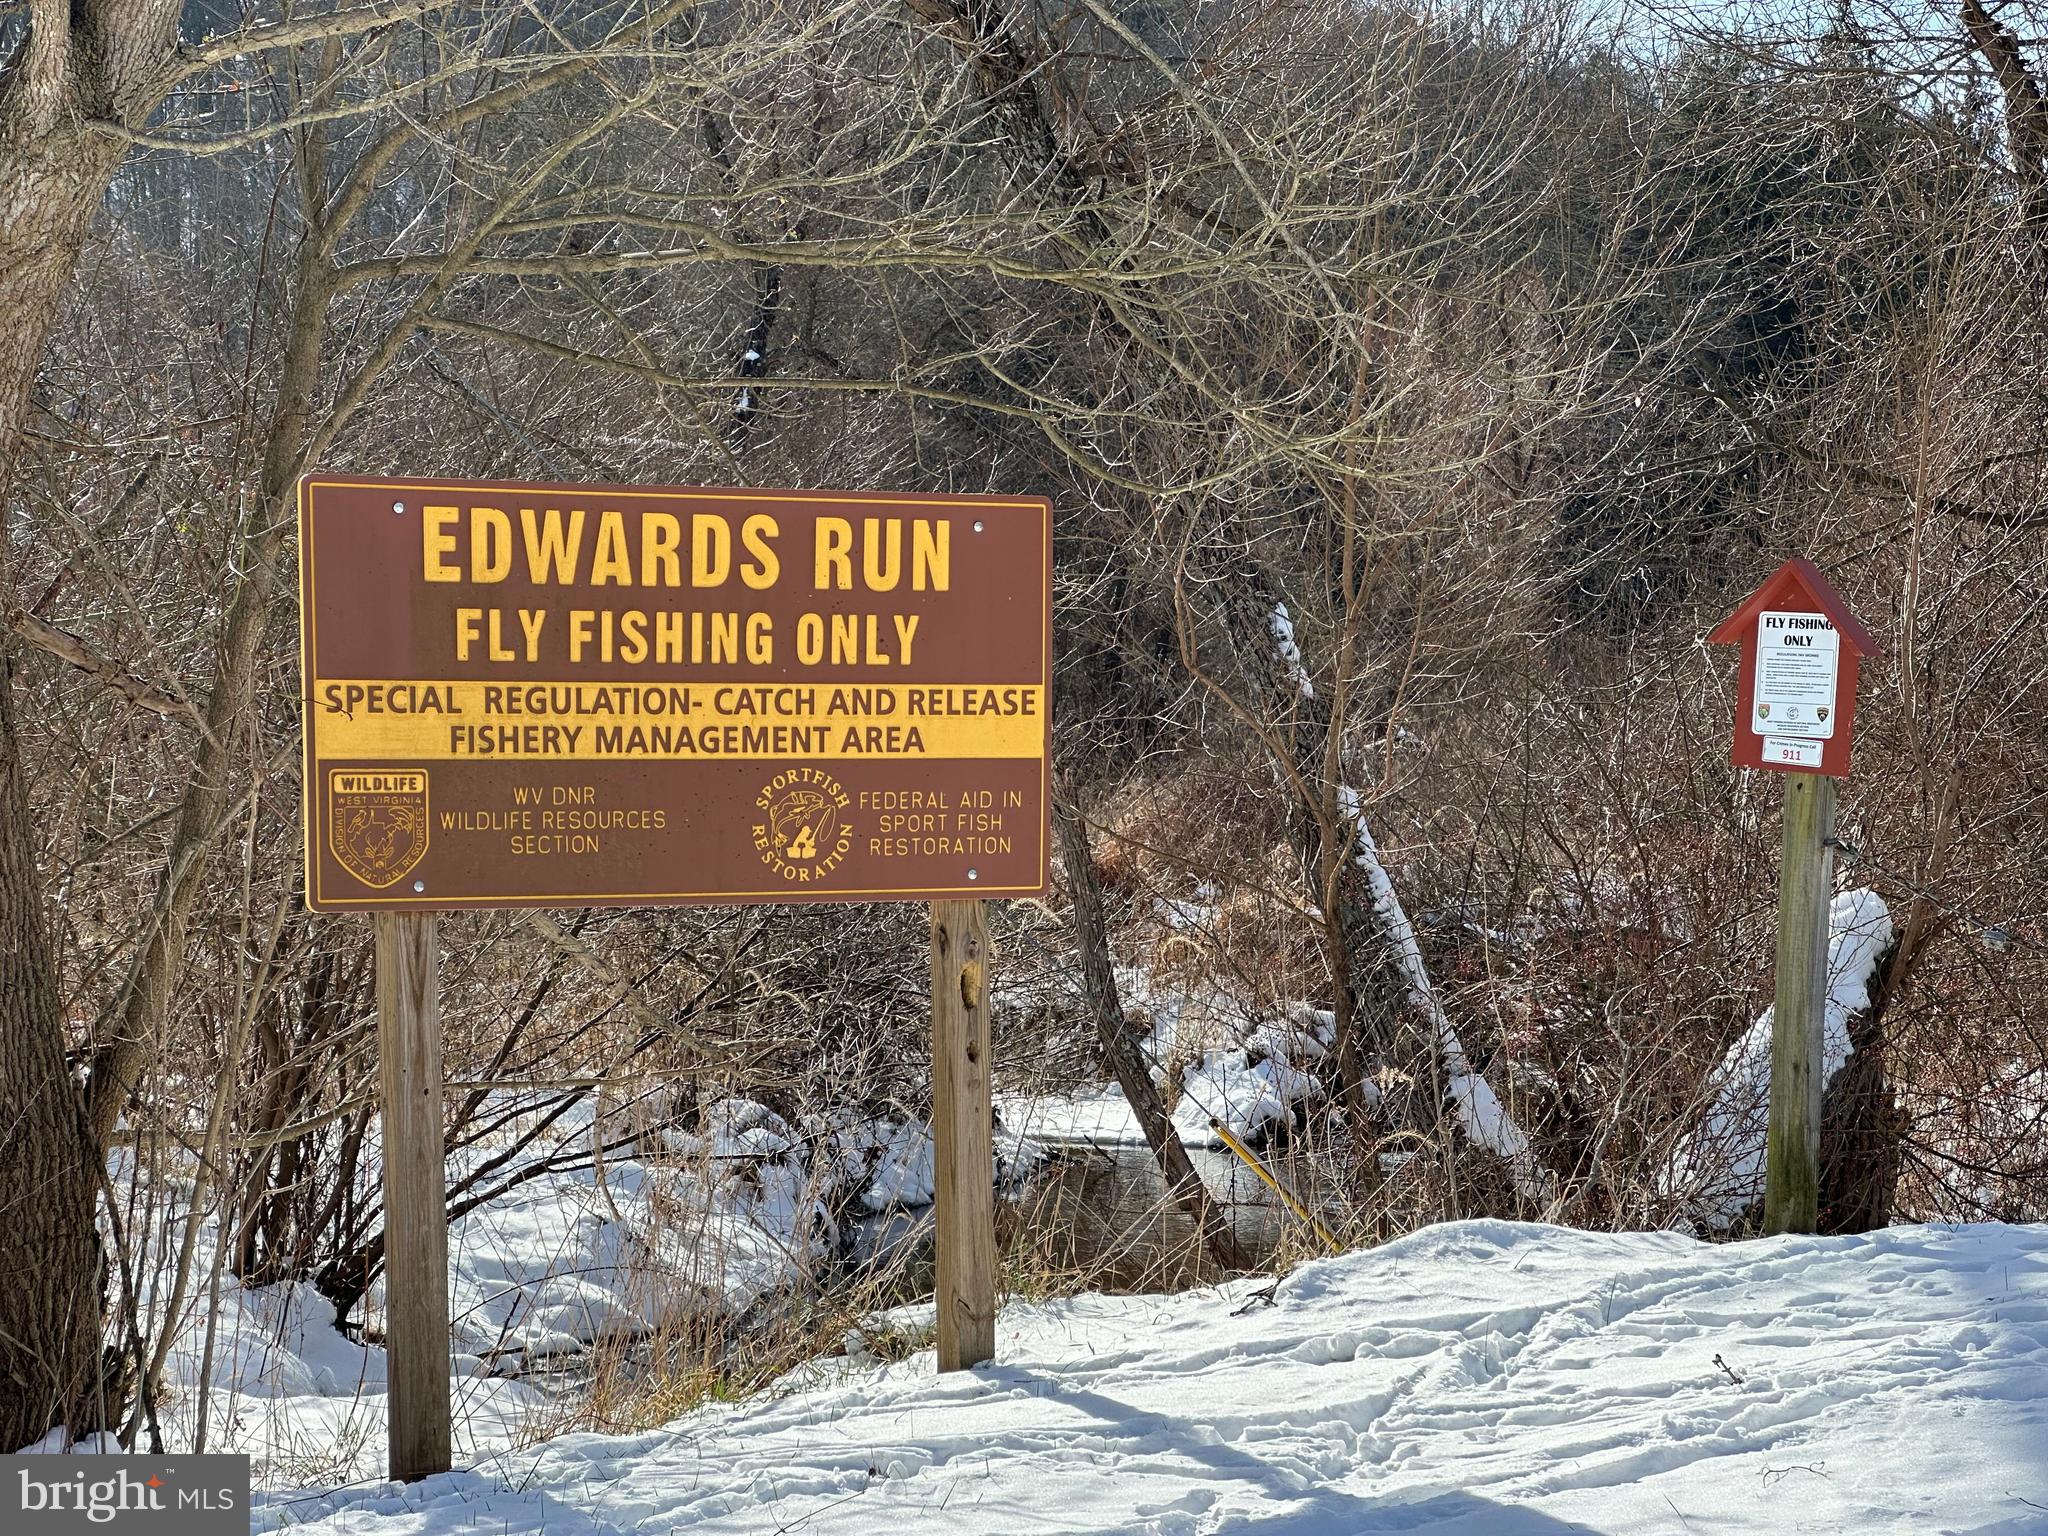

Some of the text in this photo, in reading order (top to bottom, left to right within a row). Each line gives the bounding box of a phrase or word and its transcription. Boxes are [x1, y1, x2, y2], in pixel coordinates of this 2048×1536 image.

[423, 506, 950, 592] EDWARDS RUN
[1766, 617, 1833, 631] FLY FISHING
[456, 608, 920, 665] FLY FISHING ONLY
[1784, 635, 1813, 646] ONLY
[325, 685, 1036, 716] SPECIAL REGULATION- CATCH AND RELEASE
[451, 725, 925, 754] FISHERY MANAGEMENT AREA
[1782, 749, 1801, 761] 911
[341, 777, 417, 791] WILDLIFE
[756, 768, 850, 810] SPORTFISH
[337, 795, 422, 805] WEST VIRGINIA
[513, 787, 595, 805] WV DNR
[859, 791, 1022, 809] FEDERAL AID IN
[440, 811, 666, 830] WILDLIFE RESOURCES
[879, 814, 1002, 832] SPORT FISH
[335, 807, 424, 884] DIVISION OF NATURAL RESOURCES
[511, 835, 599, 854] SECTION
[752, 824, 853, 881] RESTORATION
[870, 837, 1011, 856] RESTORATION
